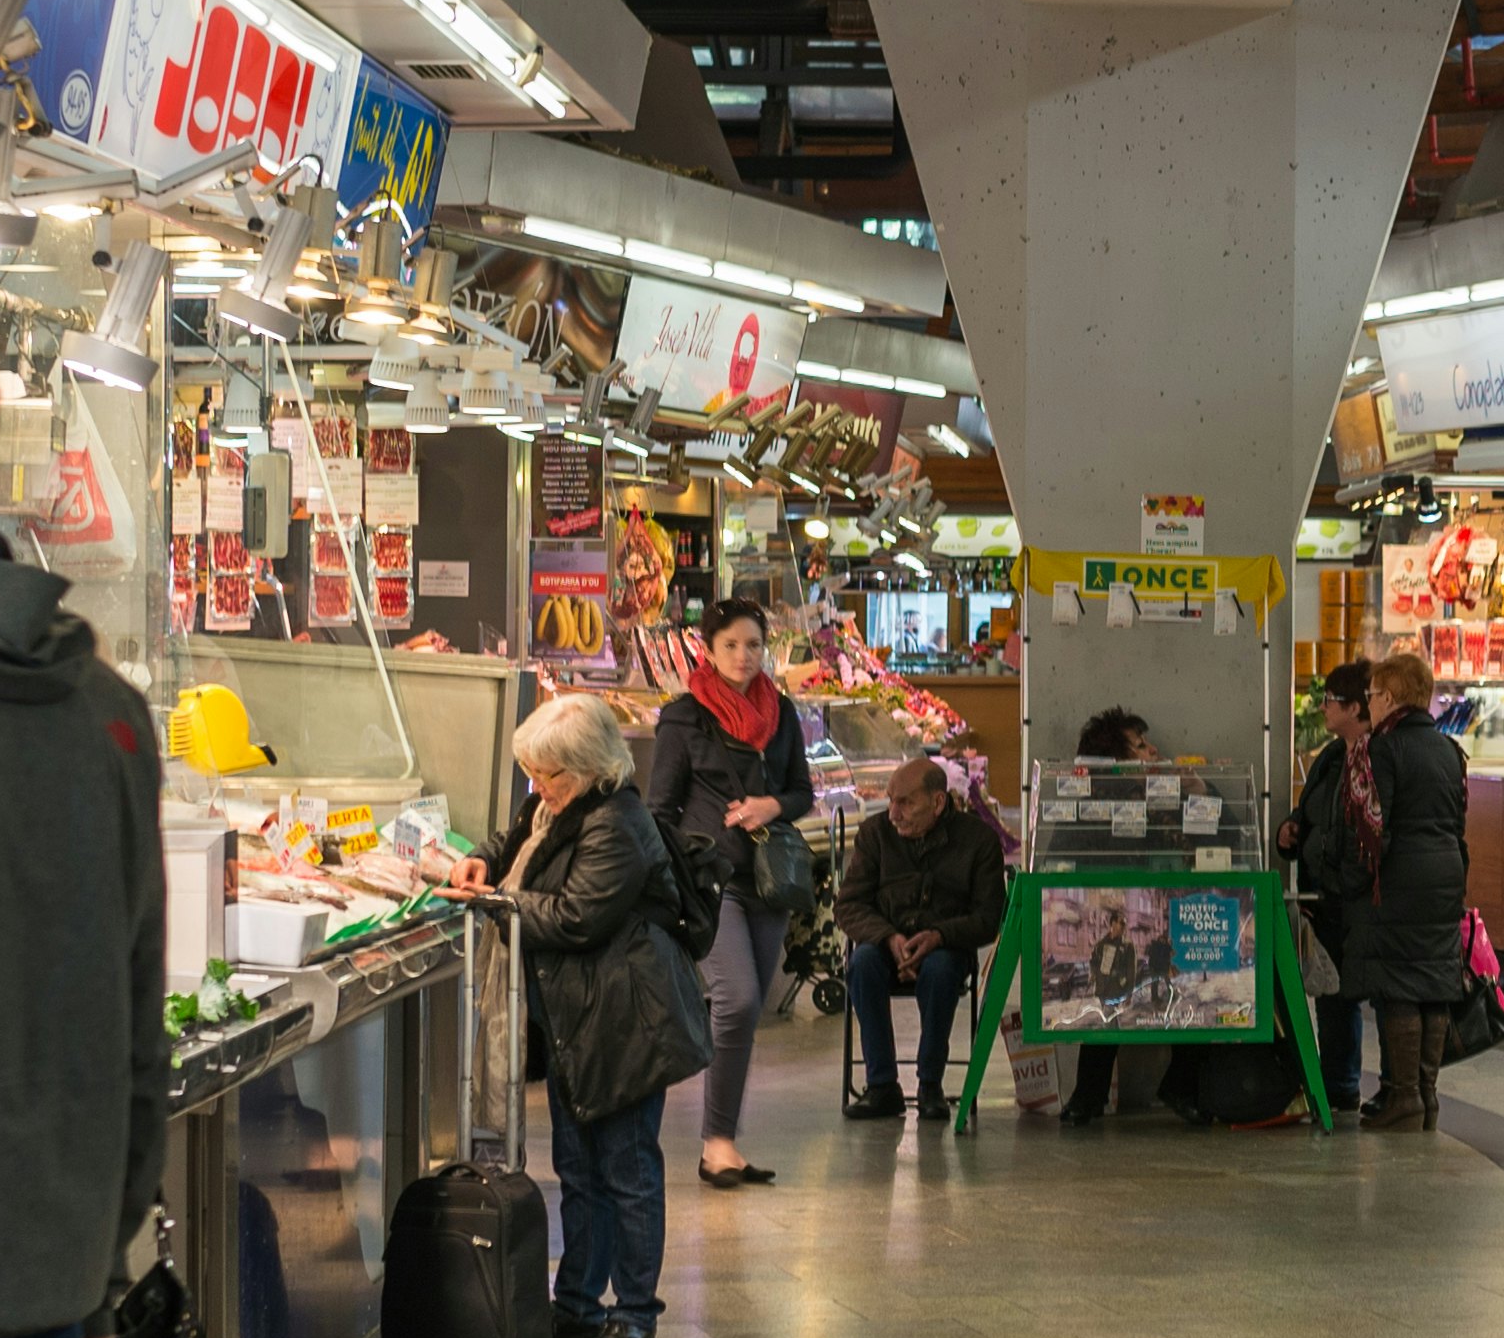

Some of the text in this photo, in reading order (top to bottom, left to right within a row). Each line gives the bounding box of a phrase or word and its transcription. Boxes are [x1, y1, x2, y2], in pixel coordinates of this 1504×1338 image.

[539, 576, 580, 587] BOTIFARRA
[1122, 567, 1209, 590] ONCE
[327, 807, 371, 827] FERTA
[1179, 912, 1217, 922] NADAL
[1193, 920, 1229, 931] ONCE
